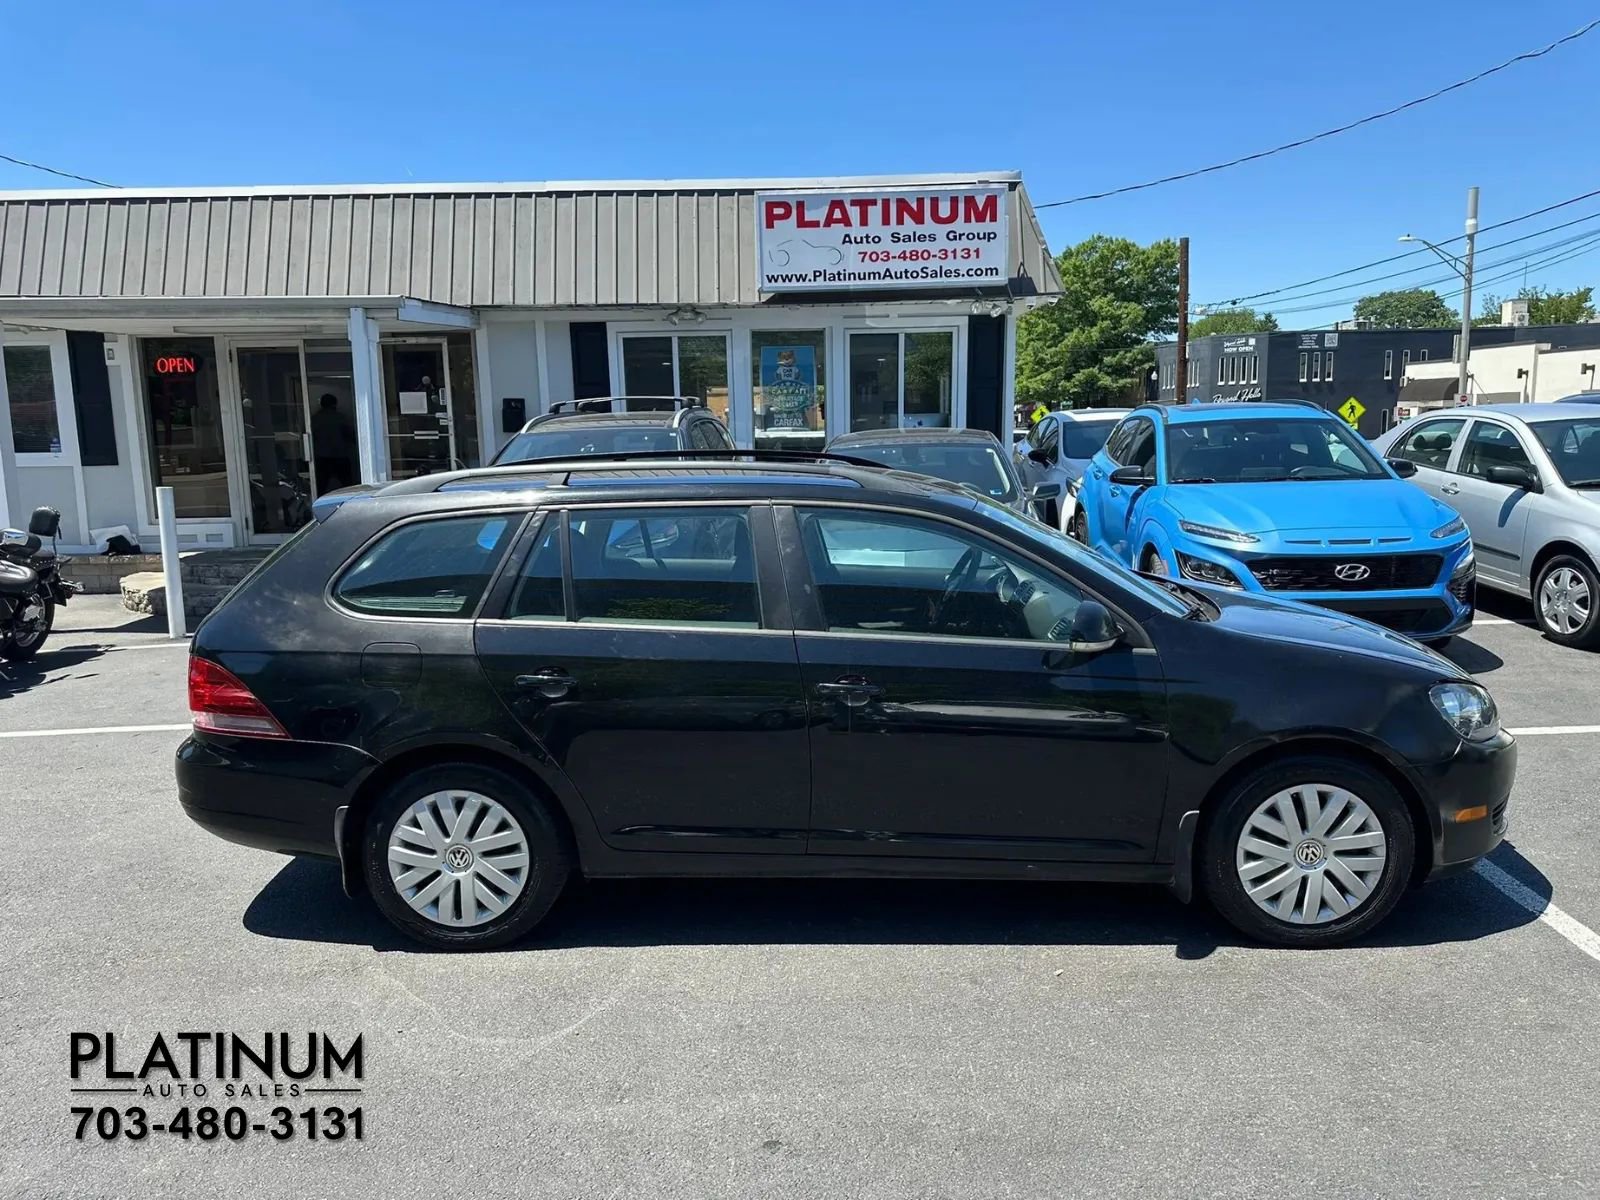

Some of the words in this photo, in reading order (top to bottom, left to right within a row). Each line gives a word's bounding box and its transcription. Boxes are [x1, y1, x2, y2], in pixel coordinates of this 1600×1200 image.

[765, 194, 998, 230] PLATINUM
[841, 233, 882, 245] Auto
[890, 231, 937, 243] Sales
[945, 230, 998, 243] Group
[857, 247, 981, 263] 703-480-3131
[765, 265, 999, 284] www.PlatinumAutoSales.com
[156, 357, 194, 373] OPEN
[774, 418, 804, 426] CARFAX
